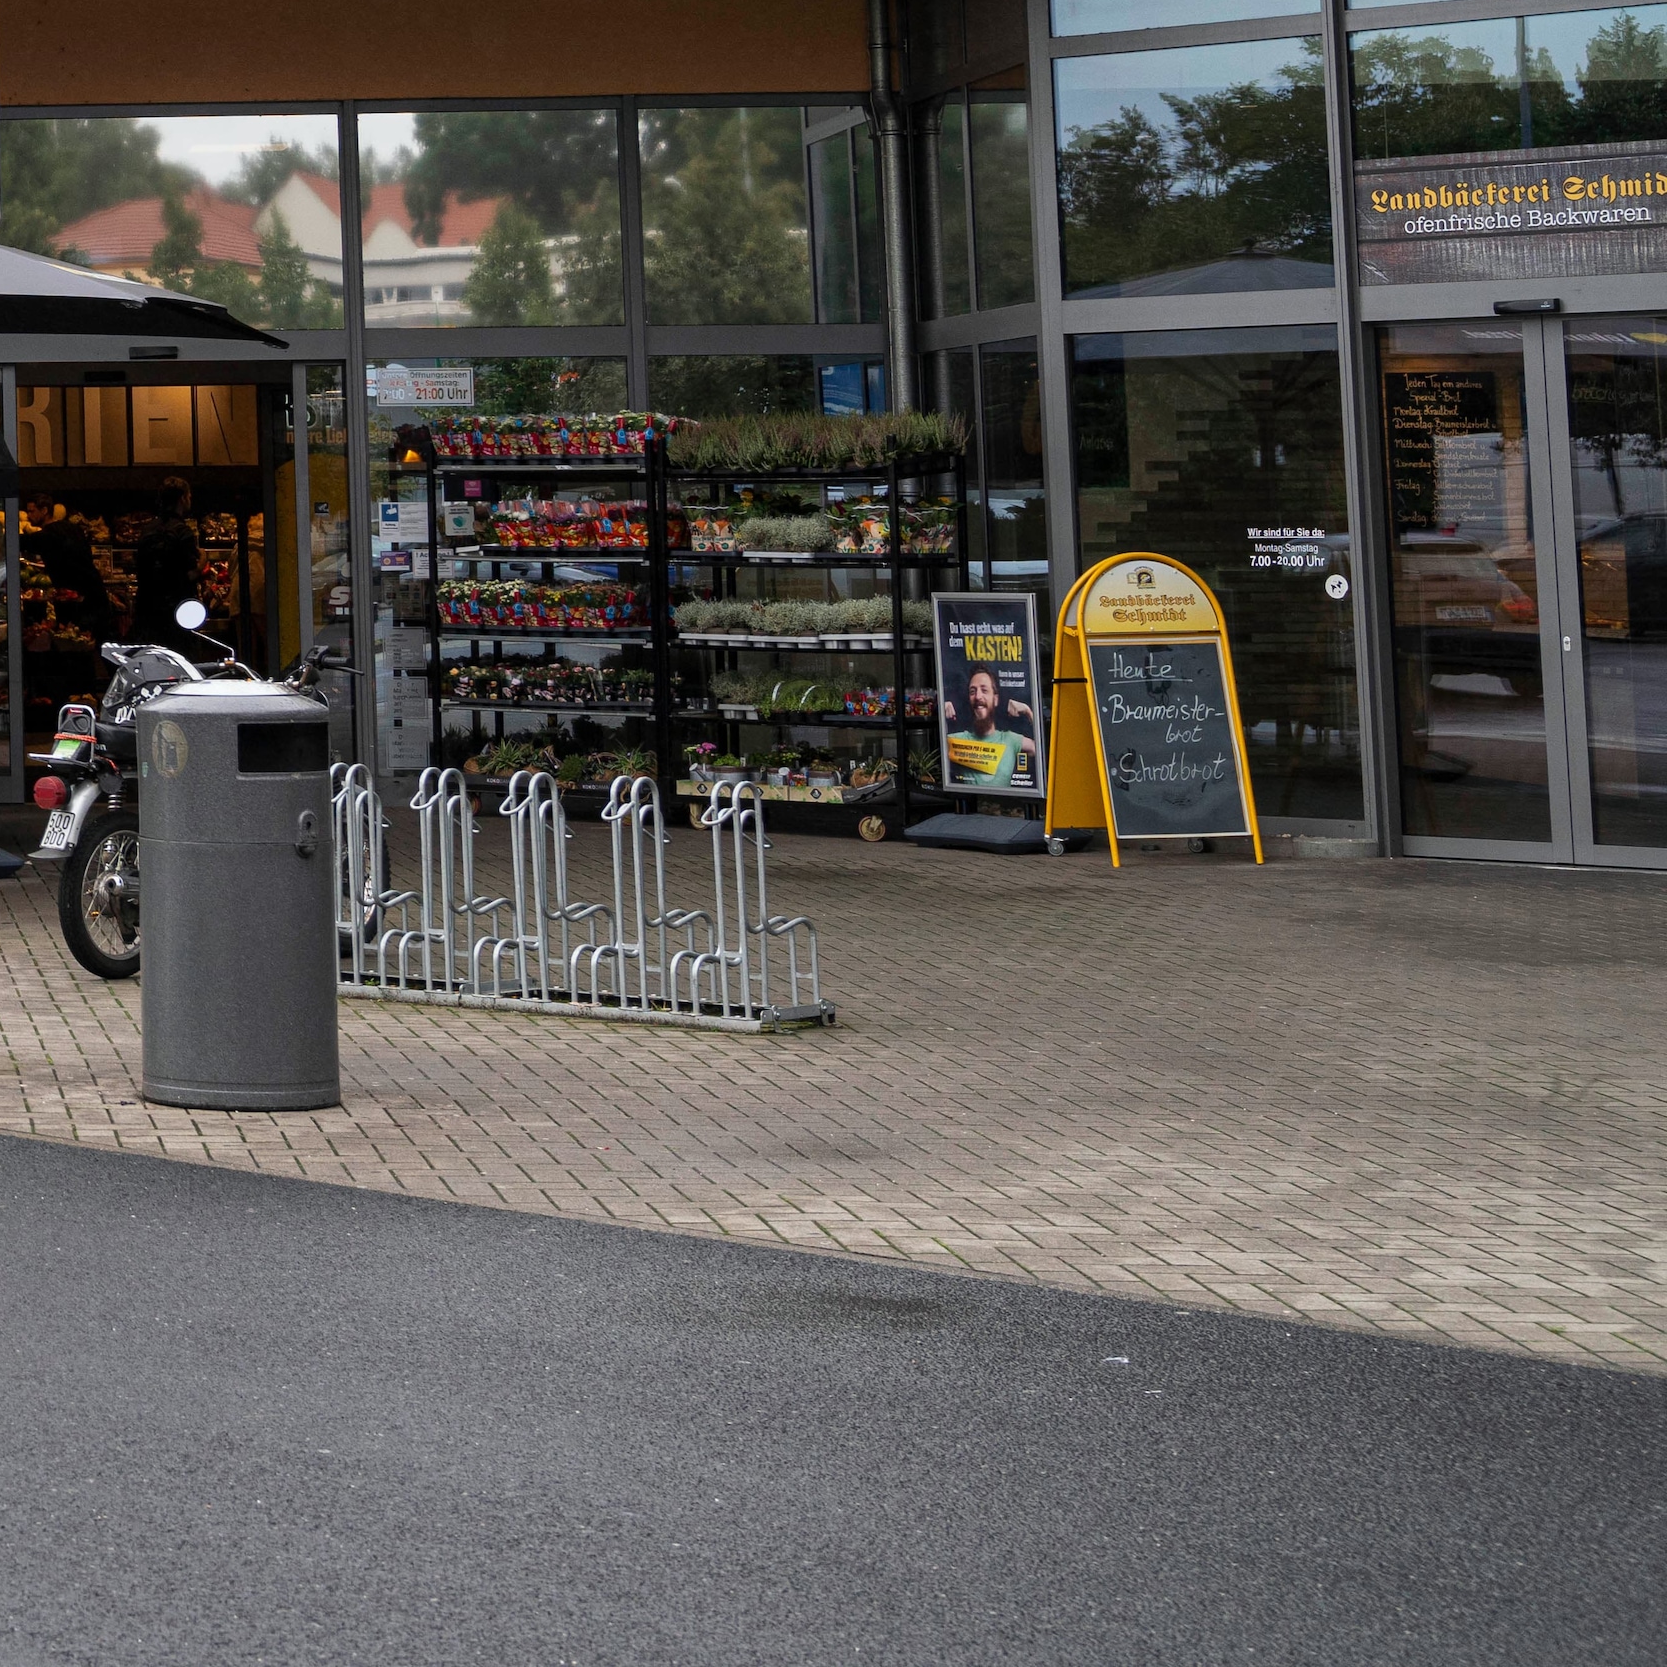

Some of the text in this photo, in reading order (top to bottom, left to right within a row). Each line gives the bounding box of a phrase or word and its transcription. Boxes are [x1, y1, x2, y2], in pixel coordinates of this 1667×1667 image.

[1370, 172, 1667, 213] Landbäckerei Schmid
[1404, 206, 1652, 234] ofenfrische Backwaren
[410, 371, 468, 381] Öffnungszeiten
[1425, 374, 1442, 392] Tag
[415, 388, 445, 400] 21:00
[447, 388, 469, 400] Uhr
[1247, 527, 1325, 537] Wir sind für Sie da:
[1255, 543, 1319, 555] Montag-Samstag
[1307, 555, 1325, 567] Uhr
[1099, 593, 1197, 609] Landbäckerei
[1112, 607, 1188, 626] Schmidt
[949, 621, 958, 634] Du
[949, 635, 1023, 663] dem KASTEN!
[1108, 652, 1176, 679] Heute
[1108, 693, 1225, 724] Braumeister-
[1166, 723, 1203, 744] brot
[1119, 752, 1227, 783] Schrotbrot
[48, 813, 71, 830] 500
